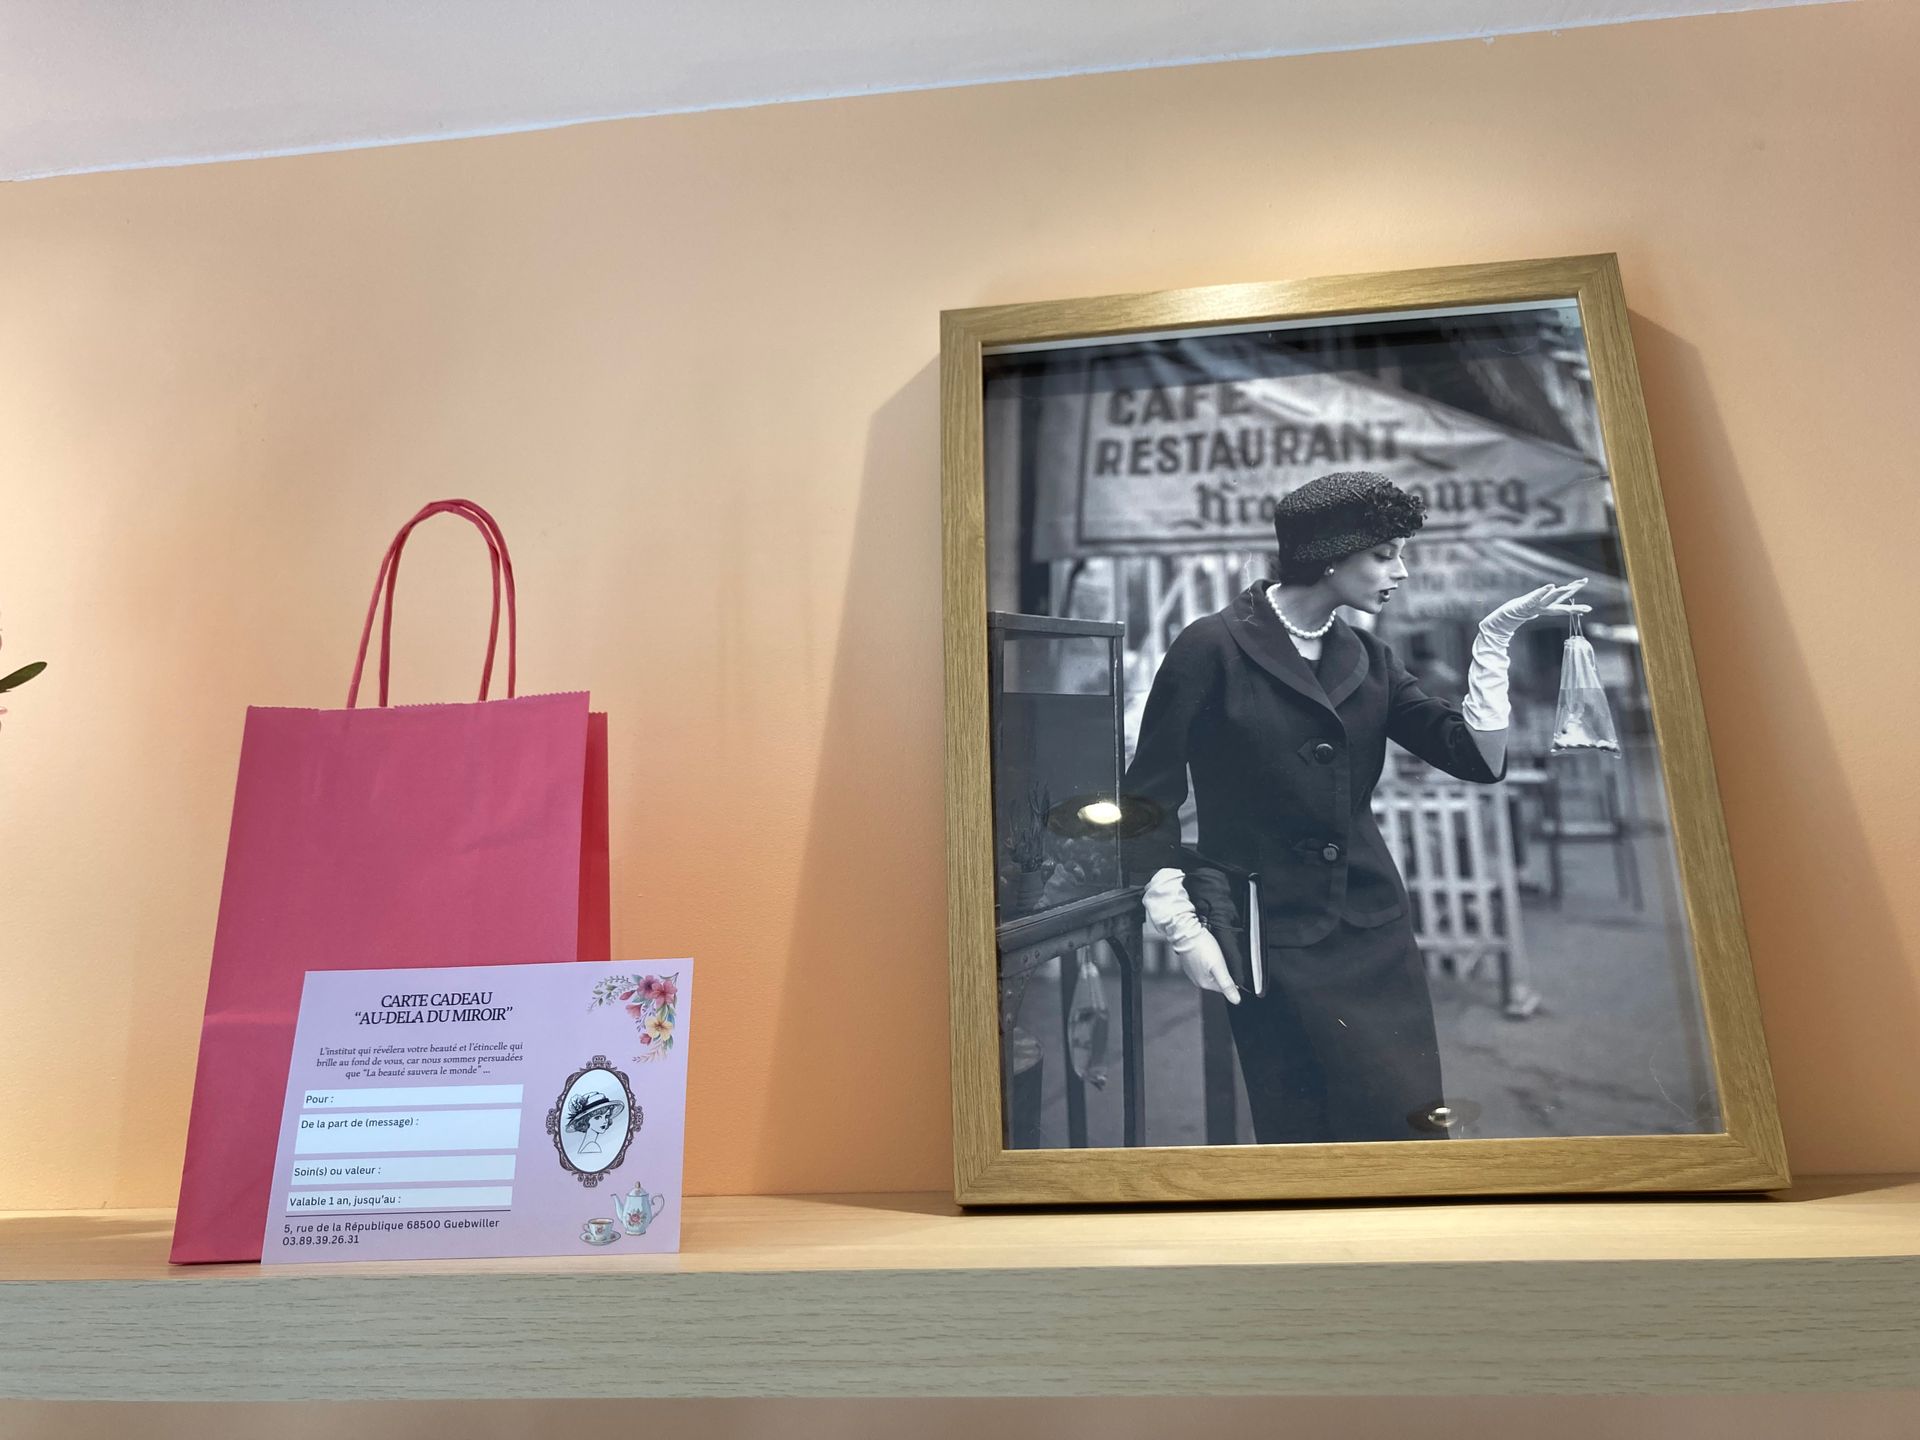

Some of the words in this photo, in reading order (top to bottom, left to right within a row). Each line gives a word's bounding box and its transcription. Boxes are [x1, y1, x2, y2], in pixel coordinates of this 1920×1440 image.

[1097, 421, 1402, 476] RESTAURANT
[381, 994, 428, 1008] CARTE
[430, 992, 493, 1006] CADEAU
[427, 1009, 451, 1023] DU
[319, 1047, 356, 1056] L'institut
[357, 1046, 372, 1057] qui
[373, 1045, 405, 1054] révélera
[430, 1043, 457, 1052] beauté
[469, 1042, 508, 1051] l'étincelle
[509, 1041, 523, 1052] qui
[316, 1058, 337, 1067] brille
[351, 1057, 371, 1067] fond
[372, 1057, 382, 1066] de
[384, 1058, 405, 1066] vous,
[443, 1056, 476, 1064] sommes
[477, 1053, 523, 1064] persuadées
[345, 1071, 360, 1080] que
[378, 1067, 406, 1077] beauté
[407, 1068, 438, 1076] sauvera
[440, 1066, 447, 1075] le
[306, 1095, 329, 1104] Pour
[301, 1120, 314, 1129] De
[316, 1119, 326, 1128] la
[327, 1119, 348, 1130] part
[350, 1119, 362, 1127] de
[365, 1116, 414, 1128] (message)
[294, 1166, 327, 1177] Soin(s)
[330, 1168, 342, 1176] ou
[345, 1166, 376, 1175] valeur
[290, 1197, 326, 1207] Valable
[329, 1197, 334, 1206] 1
[337, 1198, 351, 1207] an,
[353, 1195, 396, 1207] jusqu'au
[284, 1224, 293, 1234] 5,
[297, 1225, 313, 1233] rue
[316, 1223, 329, 1232] de
[332, 1223, 341, 1232] la
[345, 1220, 404, 1233] République
[407, 1221, 441, 1229] 68500
[444, 1219, 500, 1229] Guebwiller
[283, 1235, 359, 1246] 03.89.39.26.31
